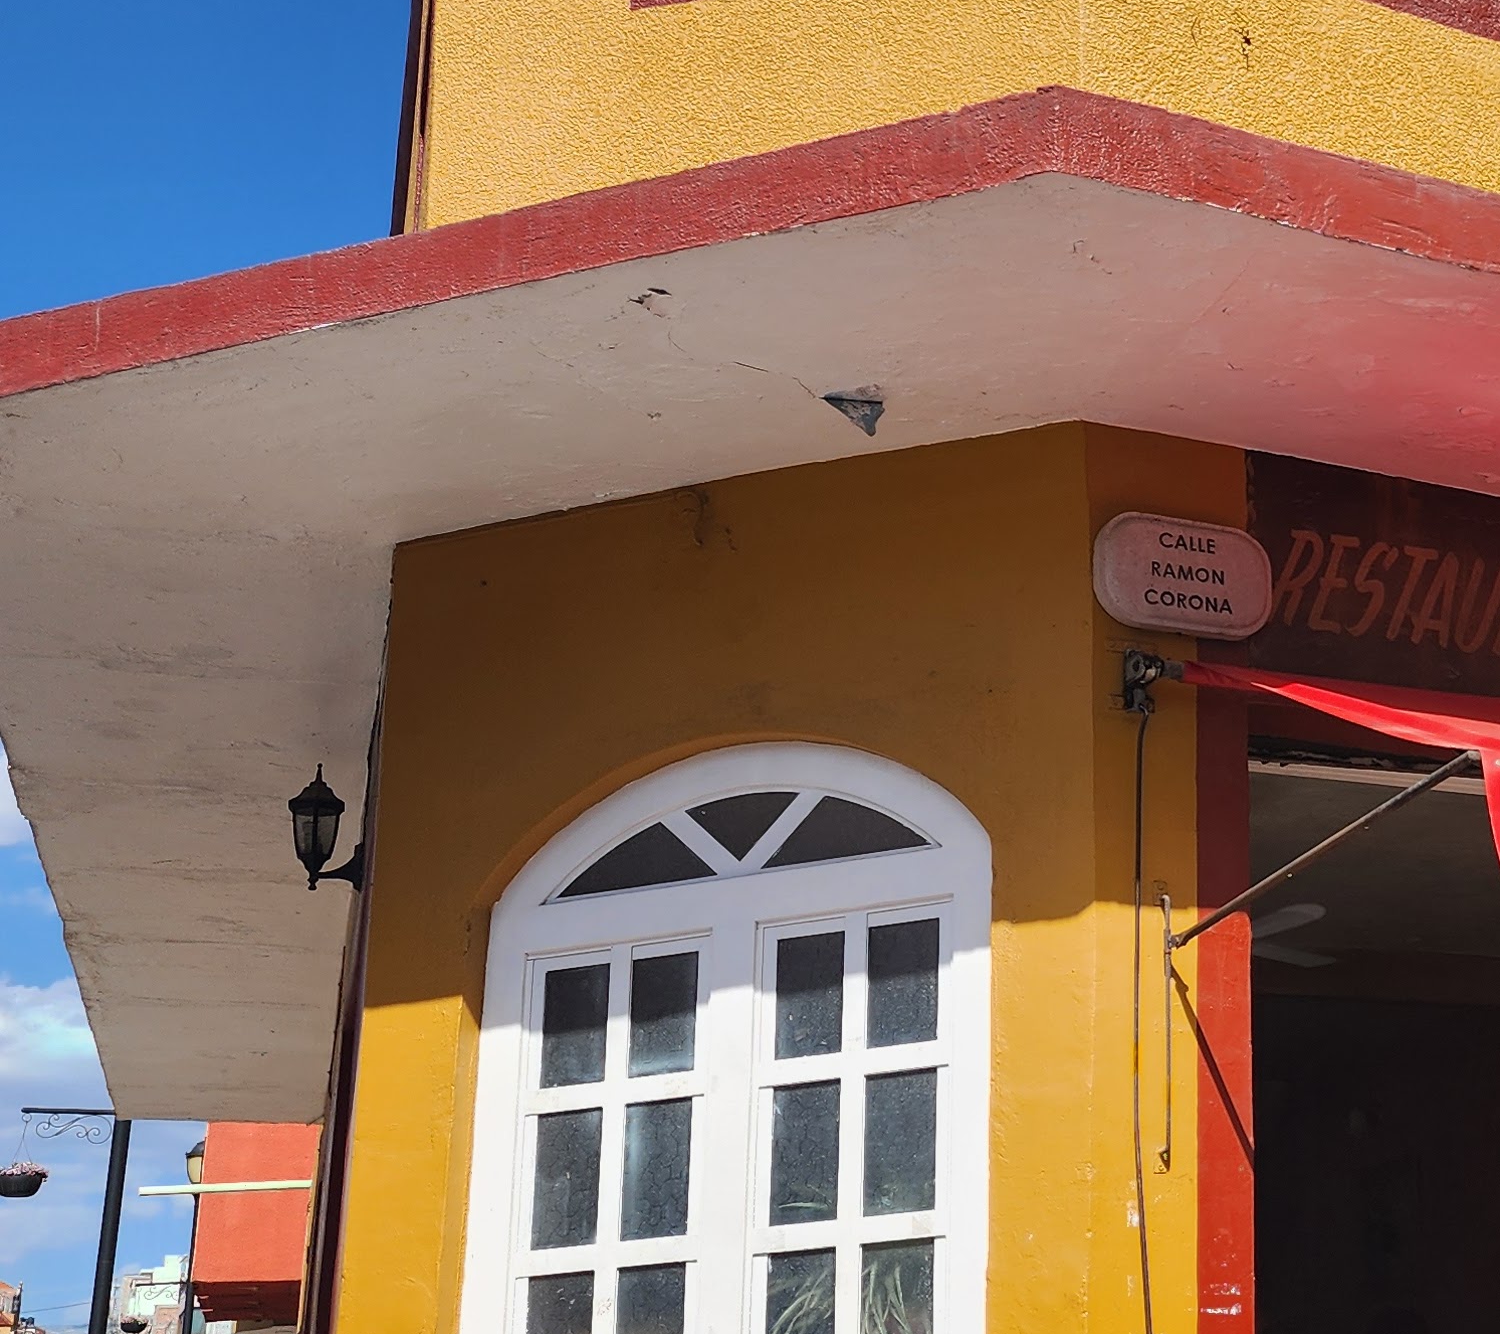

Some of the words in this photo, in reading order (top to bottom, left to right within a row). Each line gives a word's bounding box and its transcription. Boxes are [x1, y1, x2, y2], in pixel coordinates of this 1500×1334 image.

[1159, 532, 1216, 555] CALLE
[1151, 560, 1225, 585] RAMON
[1144, 589, 1233, 615] CORONA
